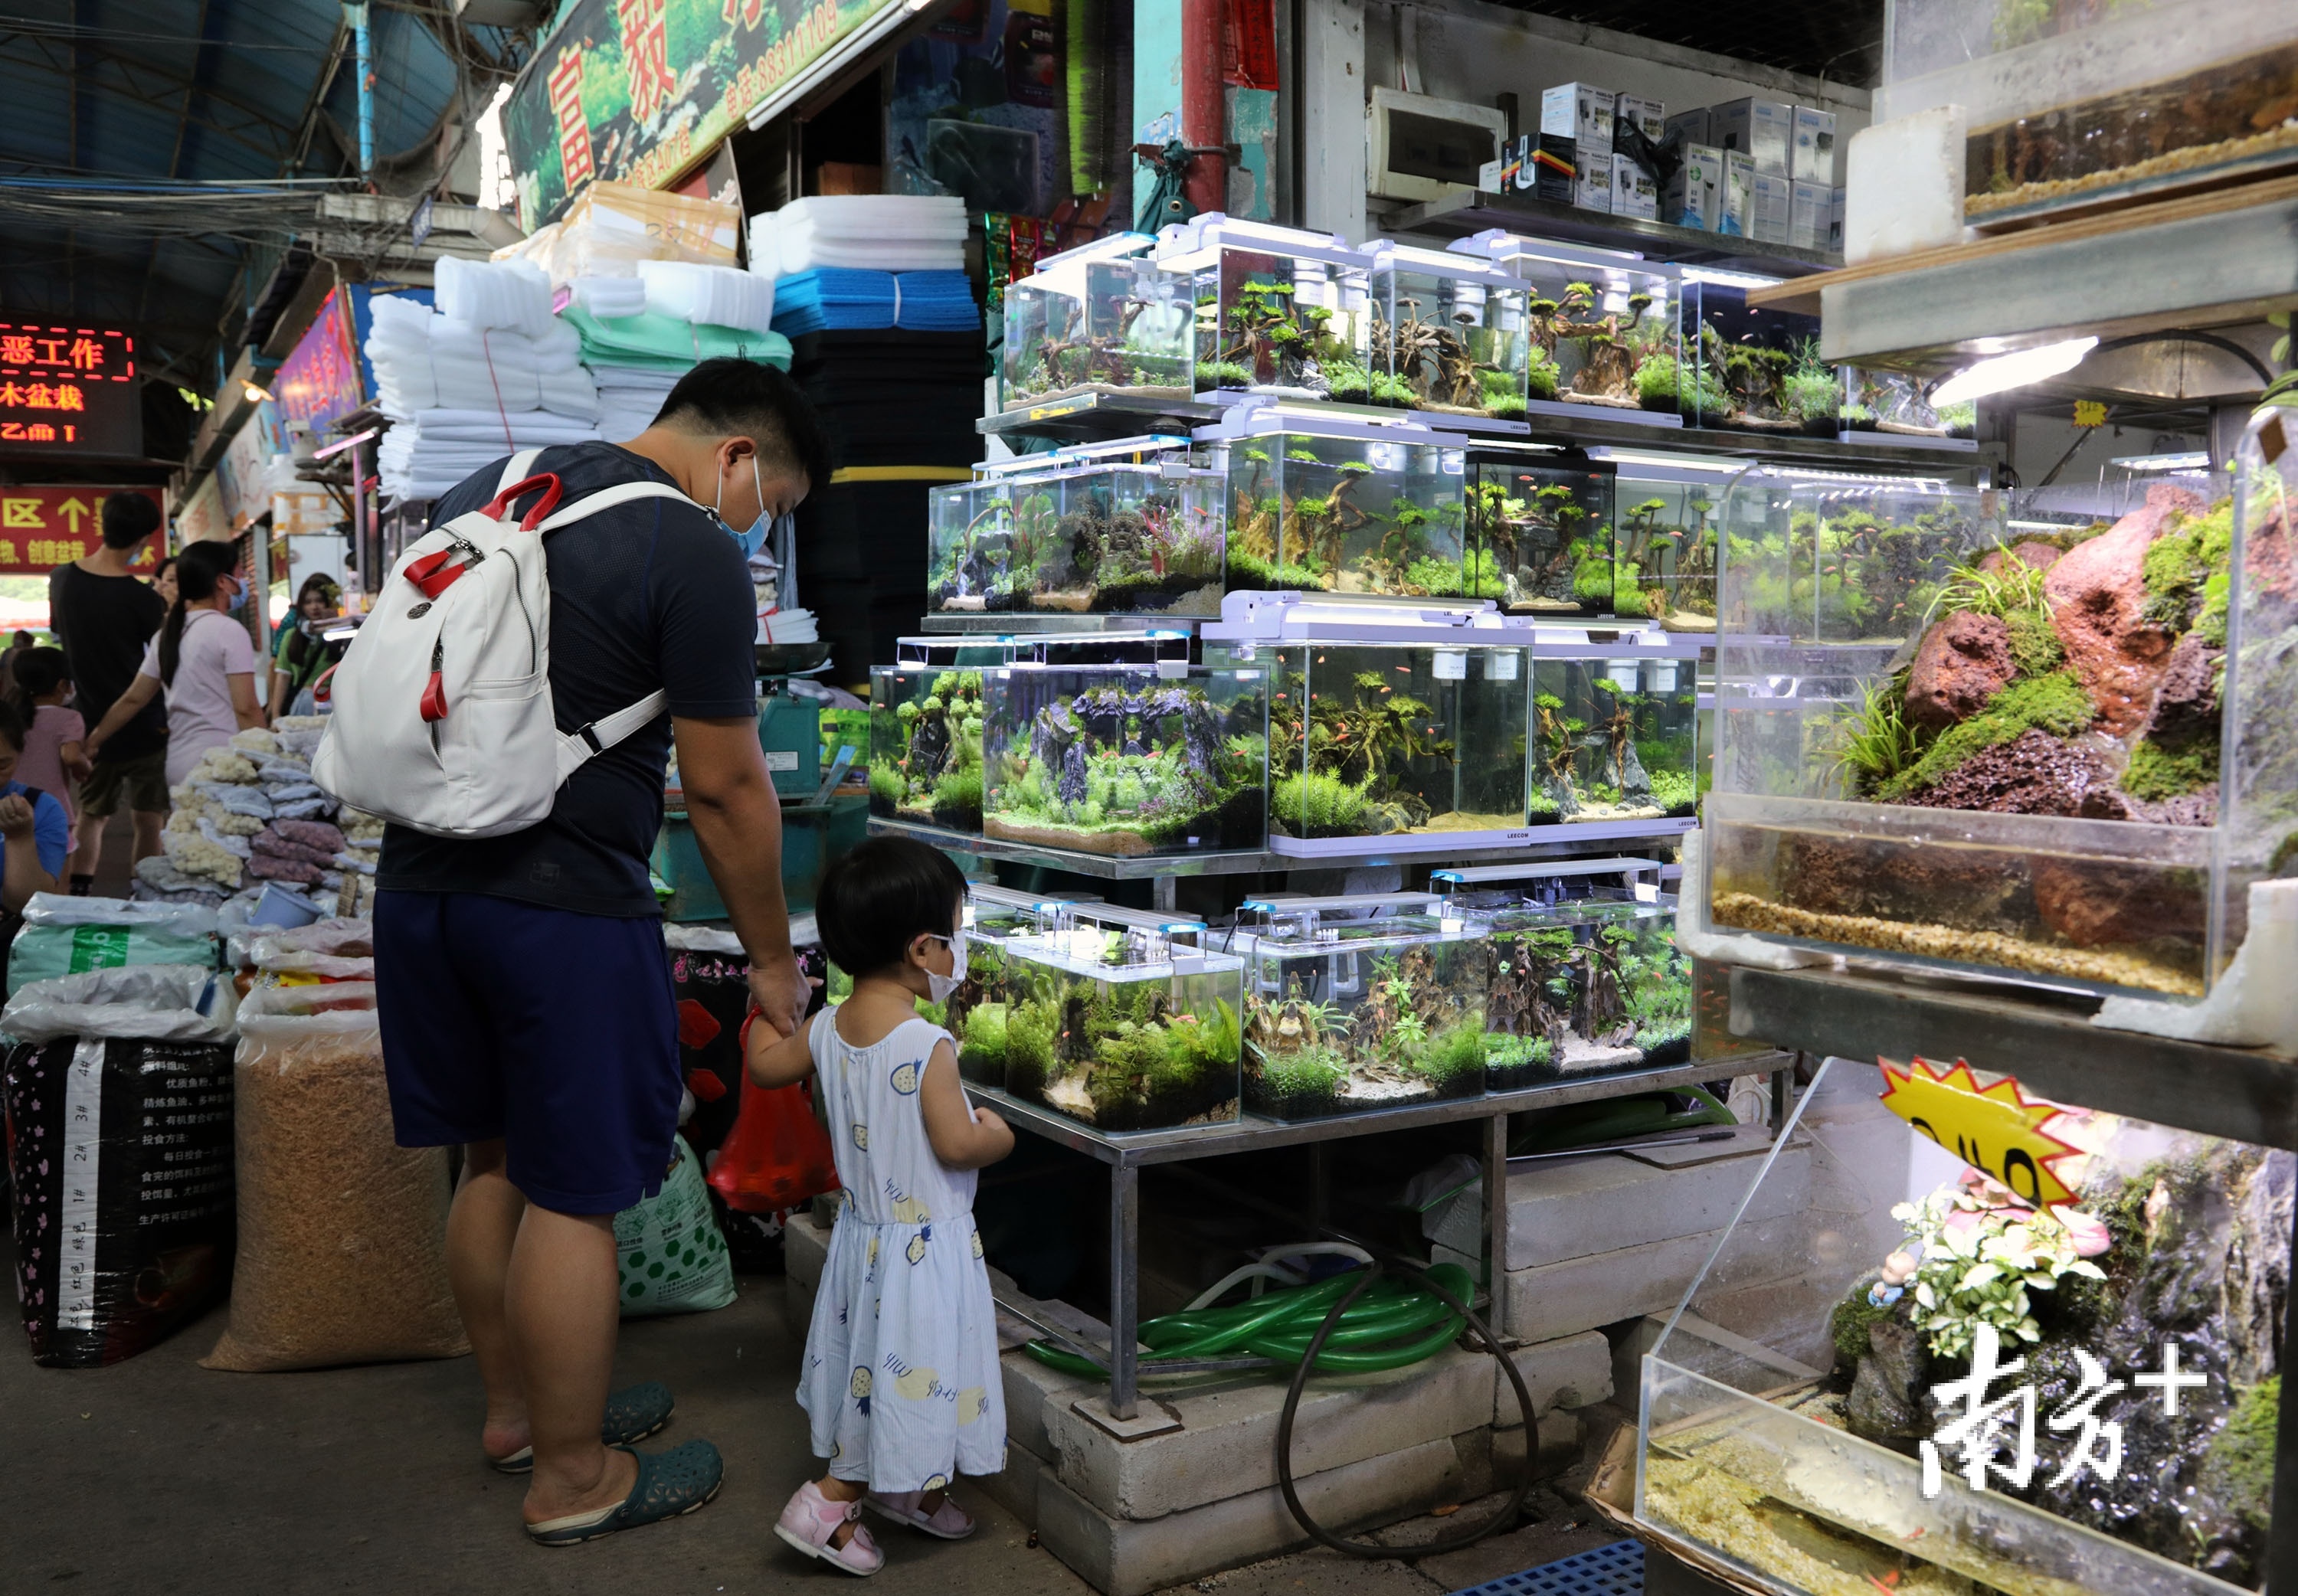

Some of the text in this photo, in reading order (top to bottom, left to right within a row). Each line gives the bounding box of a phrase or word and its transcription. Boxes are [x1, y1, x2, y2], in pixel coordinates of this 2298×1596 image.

[0, 335, 105, 370] 恶工作
[0, 381, 85, 411] 木盆栽
[2, 499, 47, 528] 区
[79, 1060, 92, 1078] 4#
[74, 1105, 88, 1122] 3#
[74, 1145, 87, 1162] 2#
[72, 1189, 86, 1203] 1#
